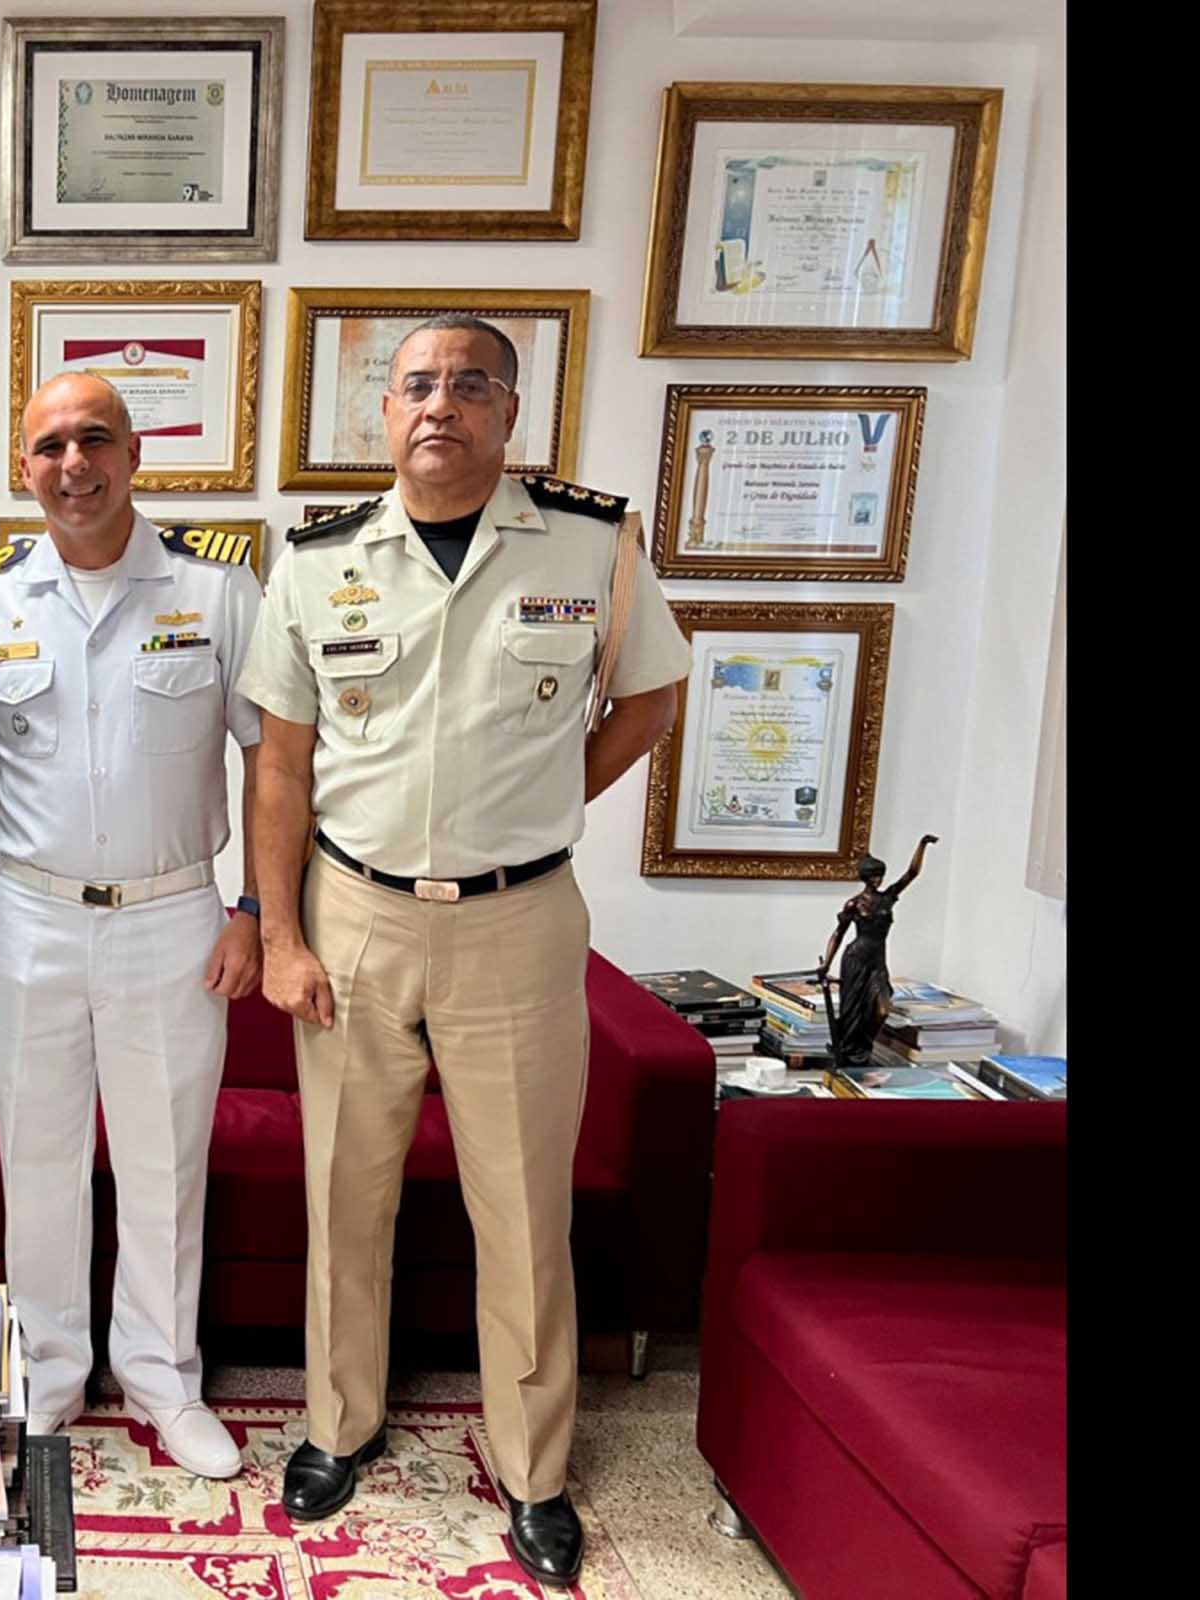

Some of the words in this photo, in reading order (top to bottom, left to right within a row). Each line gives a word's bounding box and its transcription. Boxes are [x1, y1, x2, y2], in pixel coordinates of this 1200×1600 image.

[106, 82, 196, 105] Homenagem
[726, 430, 738, 445] 2
[745, 430, 775, 446] DE
[779, 430, 850, 447] JULHO
